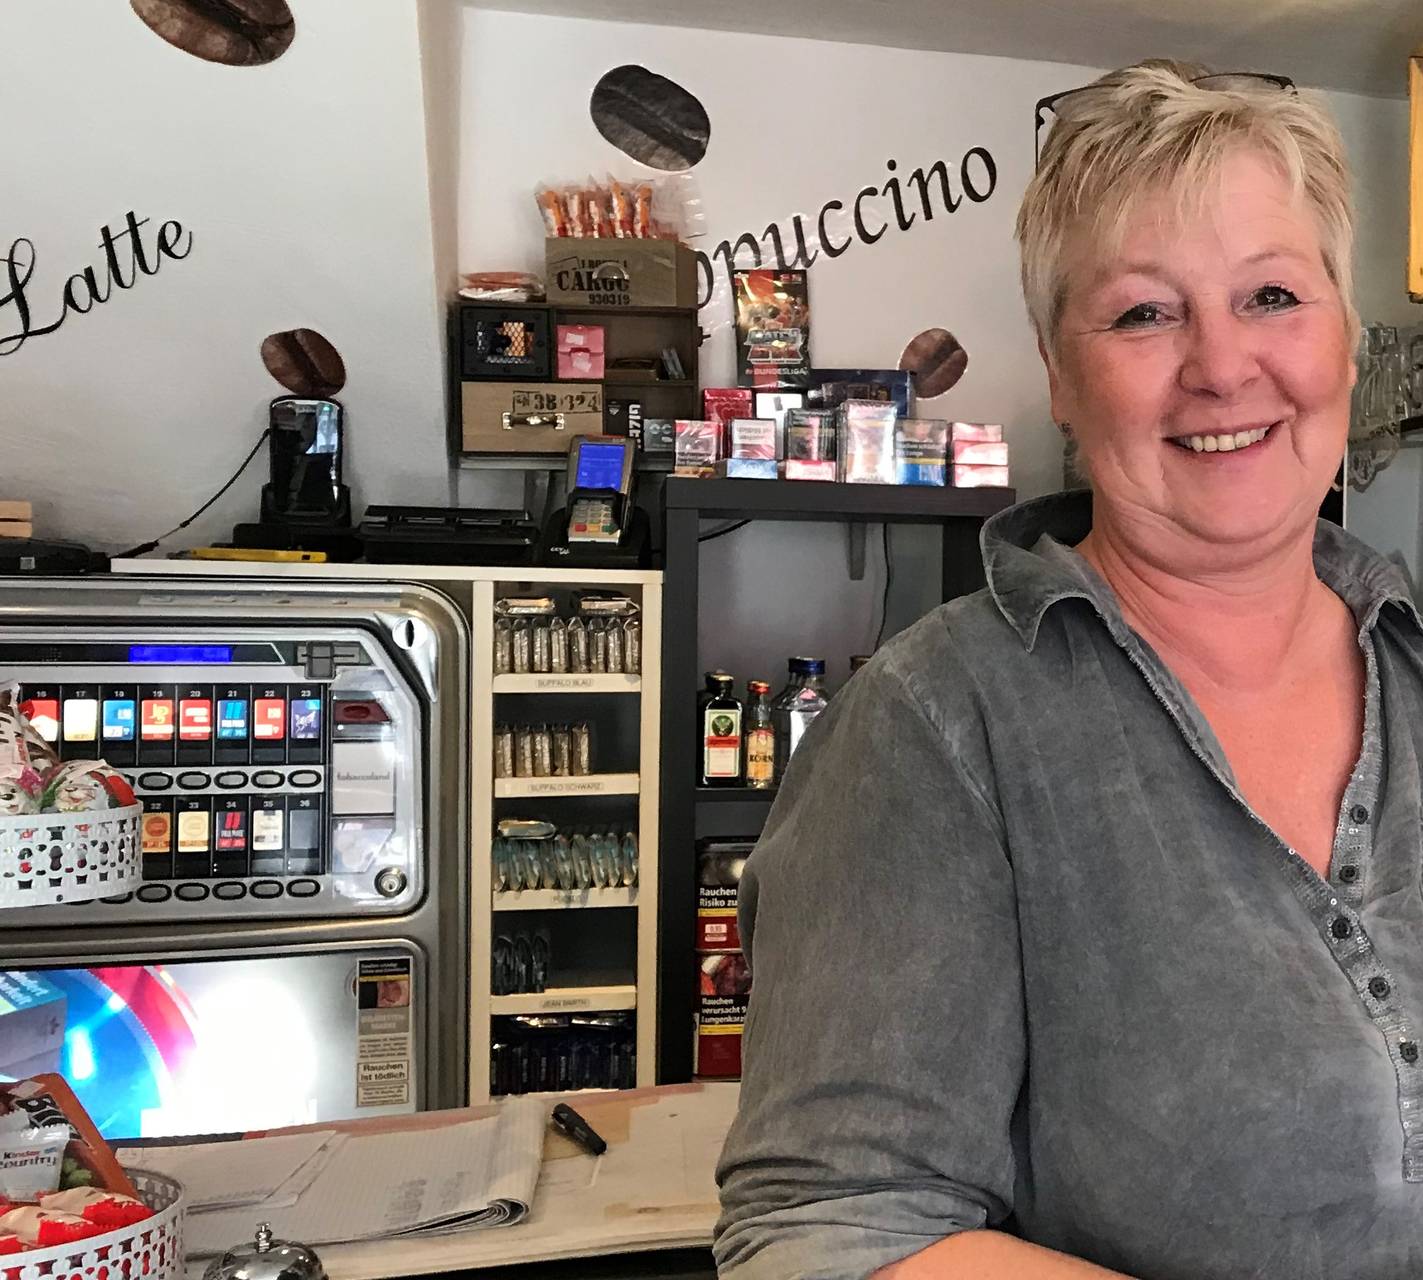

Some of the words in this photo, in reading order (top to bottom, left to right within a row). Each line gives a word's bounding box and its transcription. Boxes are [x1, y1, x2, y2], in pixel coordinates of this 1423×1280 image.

[0, 211, 194, 357] Latte
[700, 887, 737, 896] Rauchen
[700, 898, 726, 907] Risiko
[702, 997, 734, 1005] Rauchen
